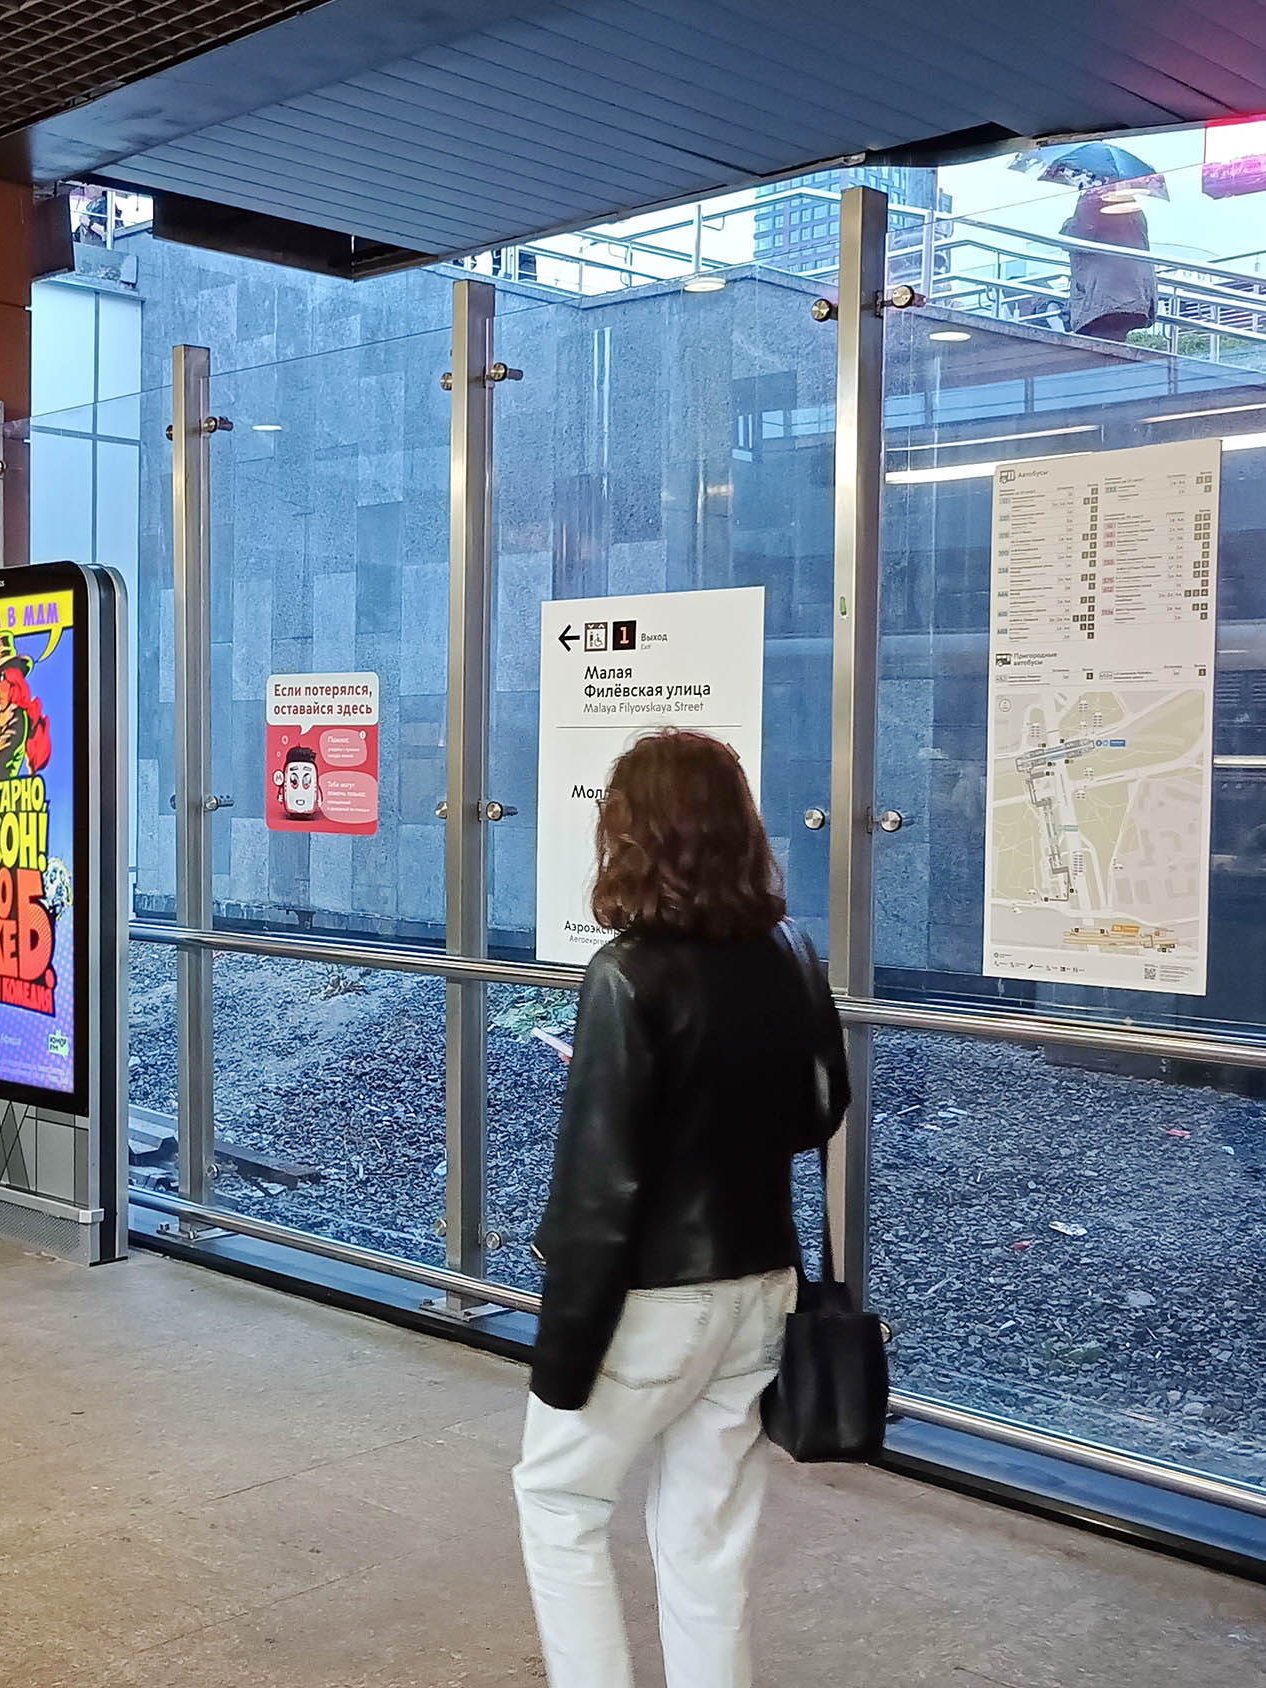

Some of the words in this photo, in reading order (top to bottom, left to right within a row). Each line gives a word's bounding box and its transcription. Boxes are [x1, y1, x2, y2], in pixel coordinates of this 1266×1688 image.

[7, 609, 16, 628] В
[23, 602, 59, 627] МДМ
[619, 626, 630, 645] 1
[640, 632, 668, 642] Выход
[584, 666, 633, 680] Малая
[274, 684, 301, 696] Если
[305, 685, 372, 699] потерялся,
[584, 683, 663, 698] Филёвская
[665, 684, 711, 700] улица
[274, 701, 334, 715] оставайся
[337, 704, 373, 717] здесь
[583, 702, 617, 715] Malaya
[619, 701, 672, 715] Filyovskaya
[674, 701, 704, 712] Street
[571, 784, 608, 800] Мол
[2, 978, 53, 1014] КОМЕДИЯ
